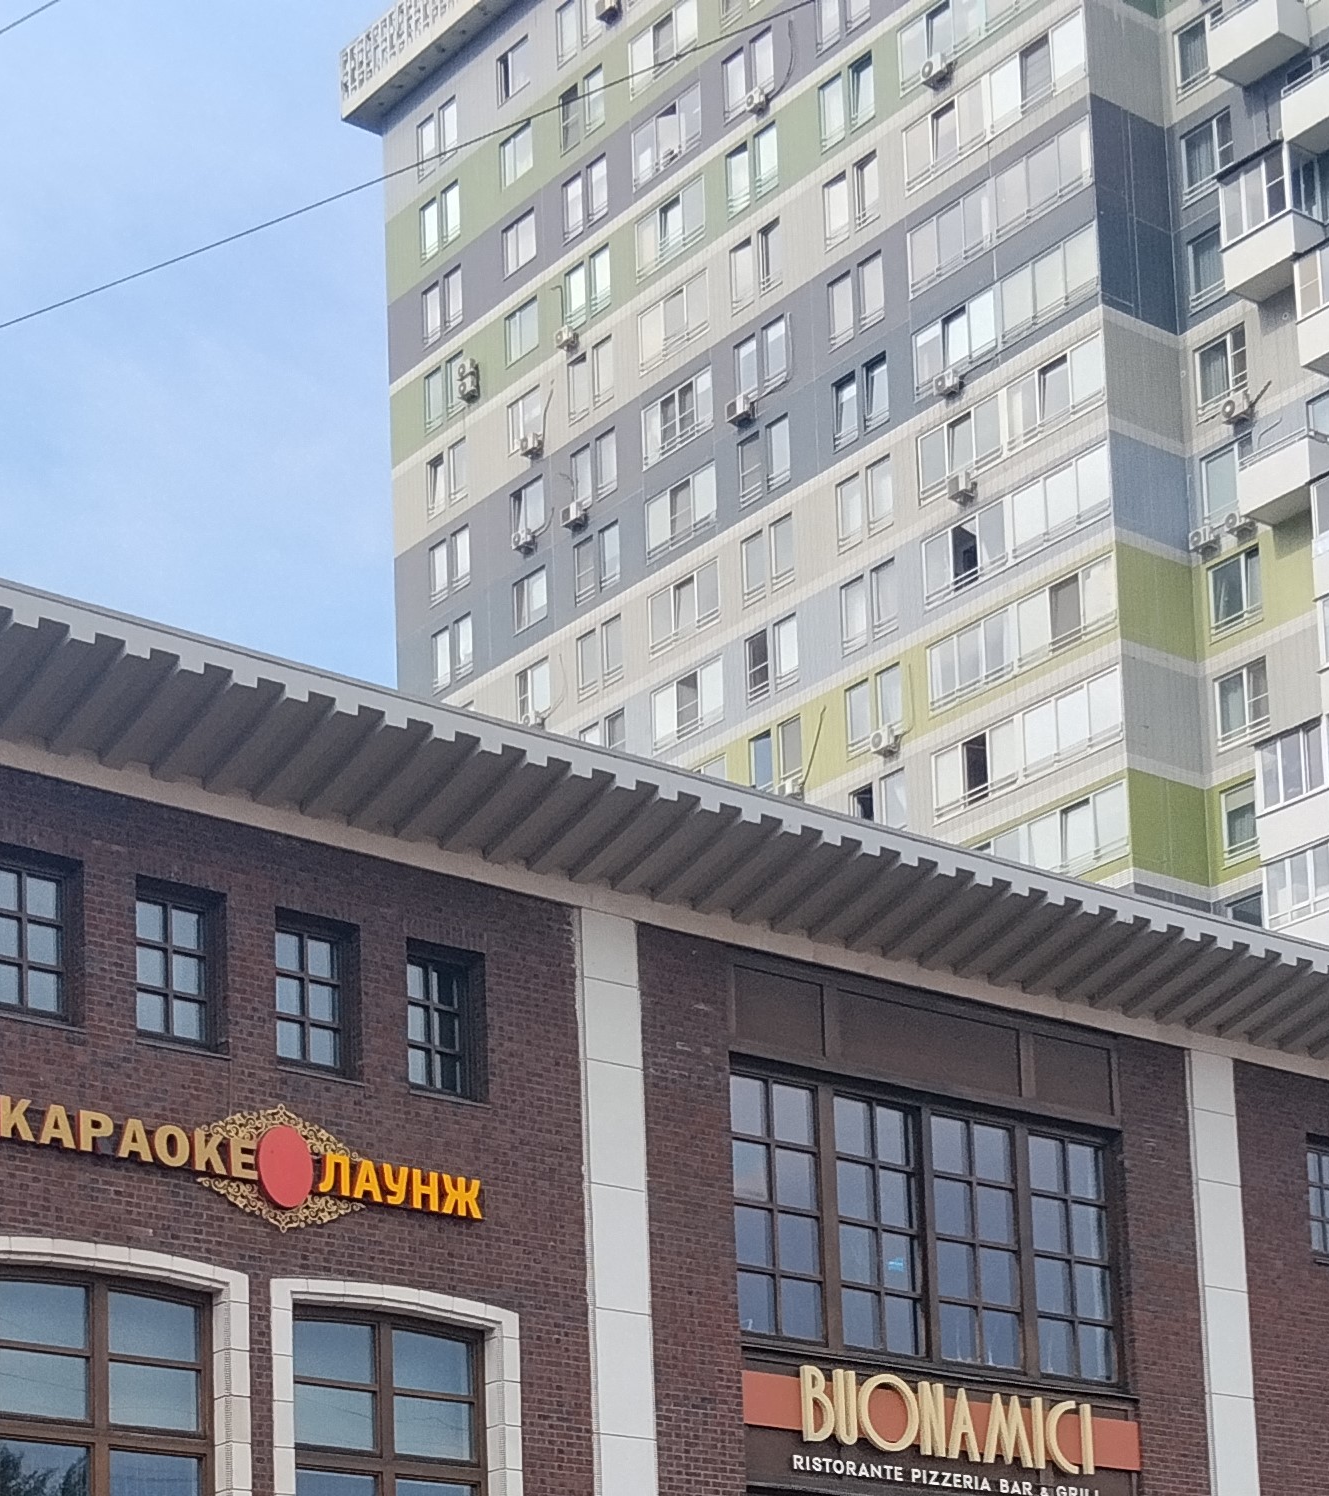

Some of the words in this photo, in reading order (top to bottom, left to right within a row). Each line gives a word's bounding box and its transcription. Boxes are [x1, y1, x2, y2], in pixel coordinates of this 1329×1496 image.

[319, 1151, 485, 1220] ЛАУНЖ
[798, 1364, 1096, 1476] BUONAMICI
[791, 1453, 904, 1483] RISTORANTE
[910, 1467, 991, 1493] PIZZERIA
